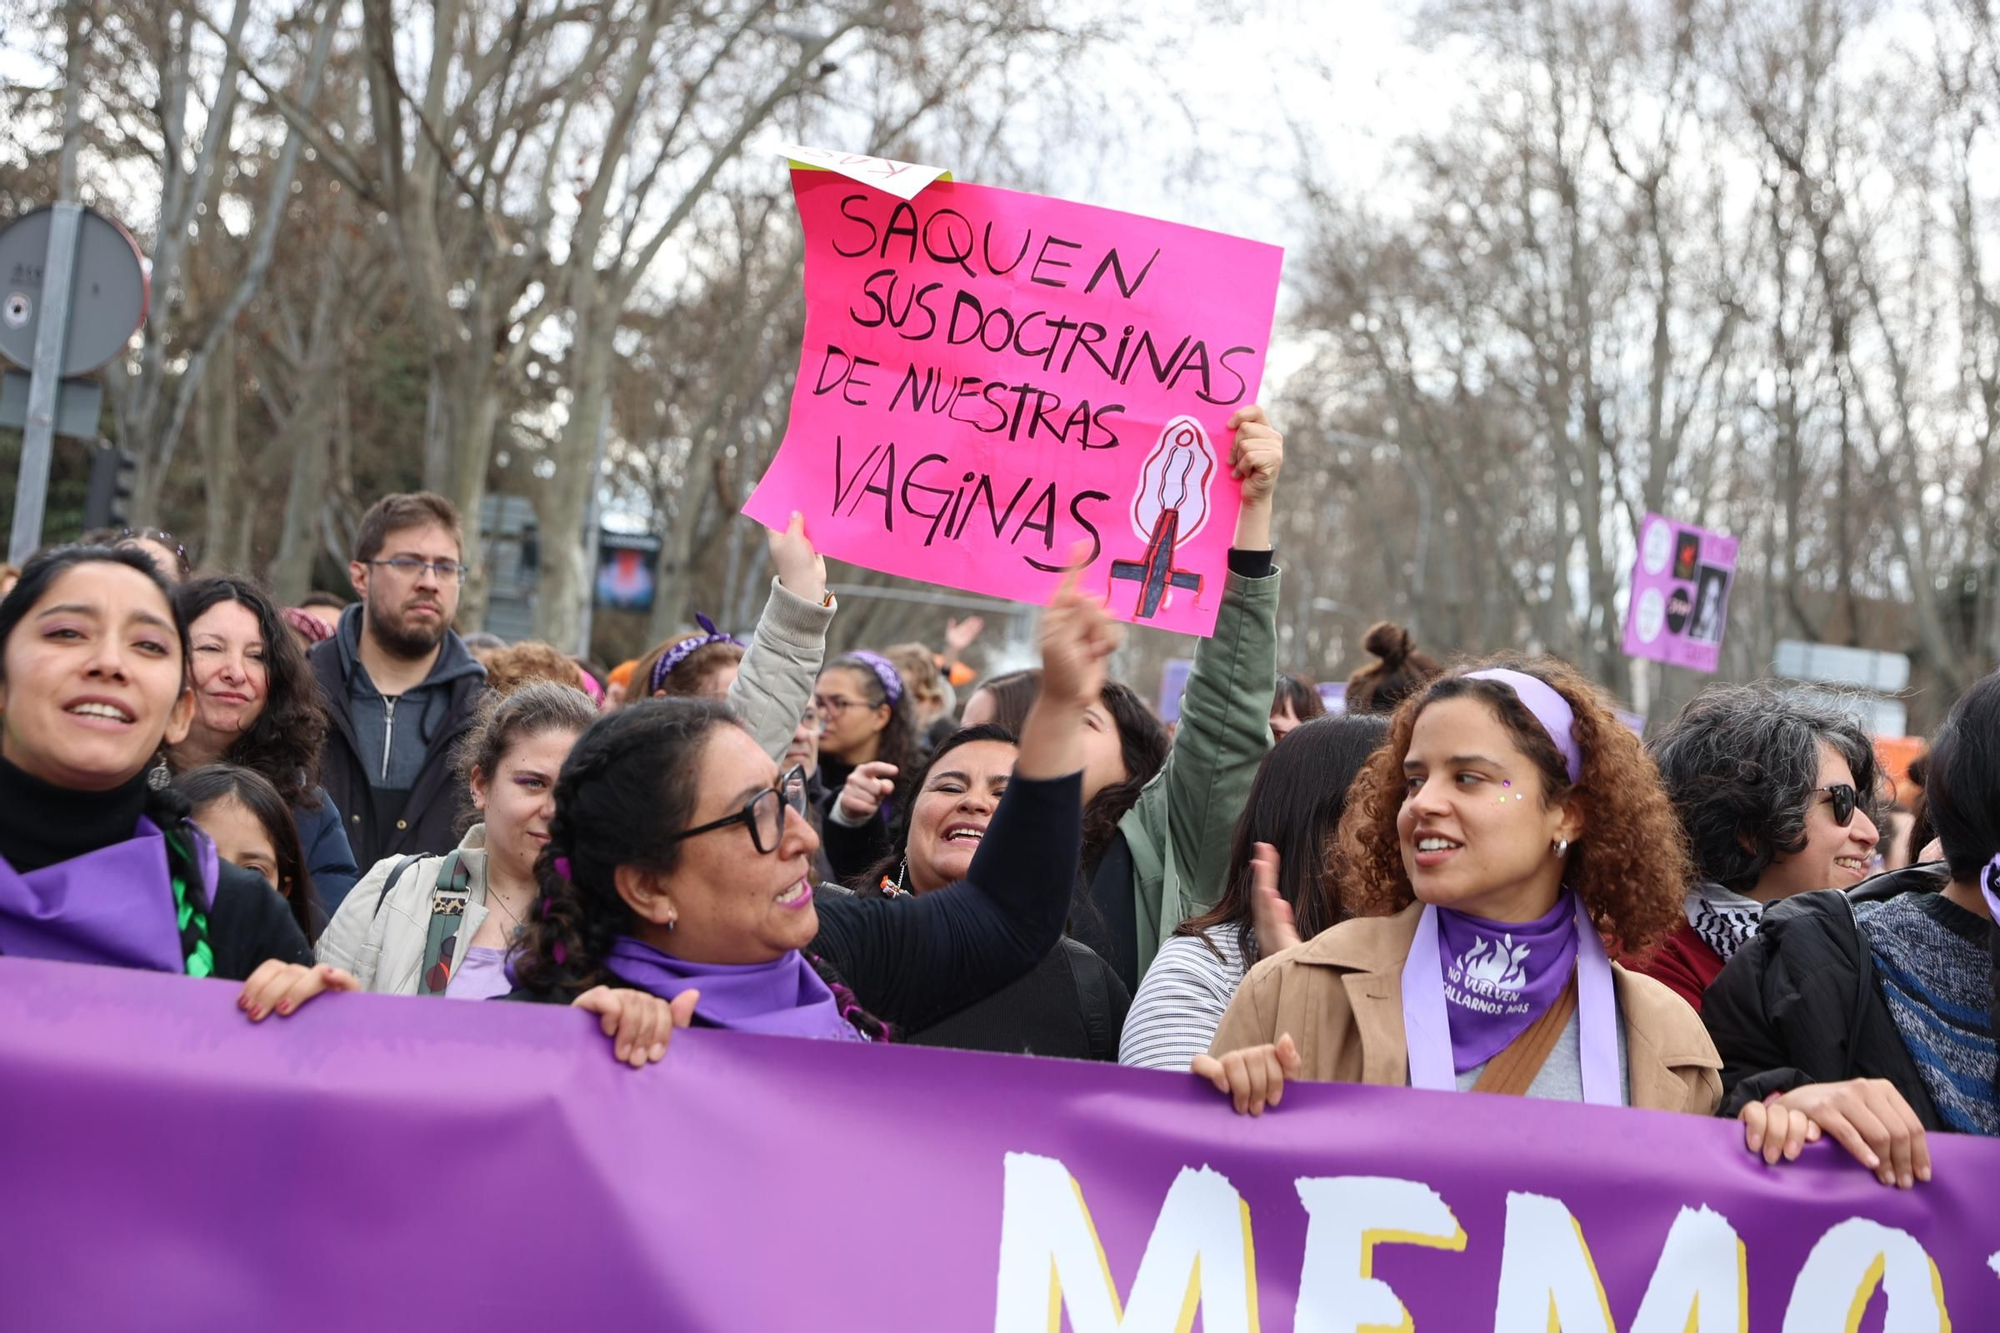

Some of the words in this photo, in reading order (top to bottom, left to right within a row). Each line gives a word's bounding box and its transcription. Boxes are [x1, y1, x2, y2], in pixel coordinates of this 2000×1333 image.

[833, 195, 1160, 298] SAQUEN
[850, 269, 943, 340] SUS
[813, 345, 880, 405] DE
[889, 363, 1125, 450] NUESTRAS
[1447, 966, 1461, 983] NO
[1464, 976, 1520, 1002] VUELVEN
[994, 1151, 2000, 1333] MEMO
